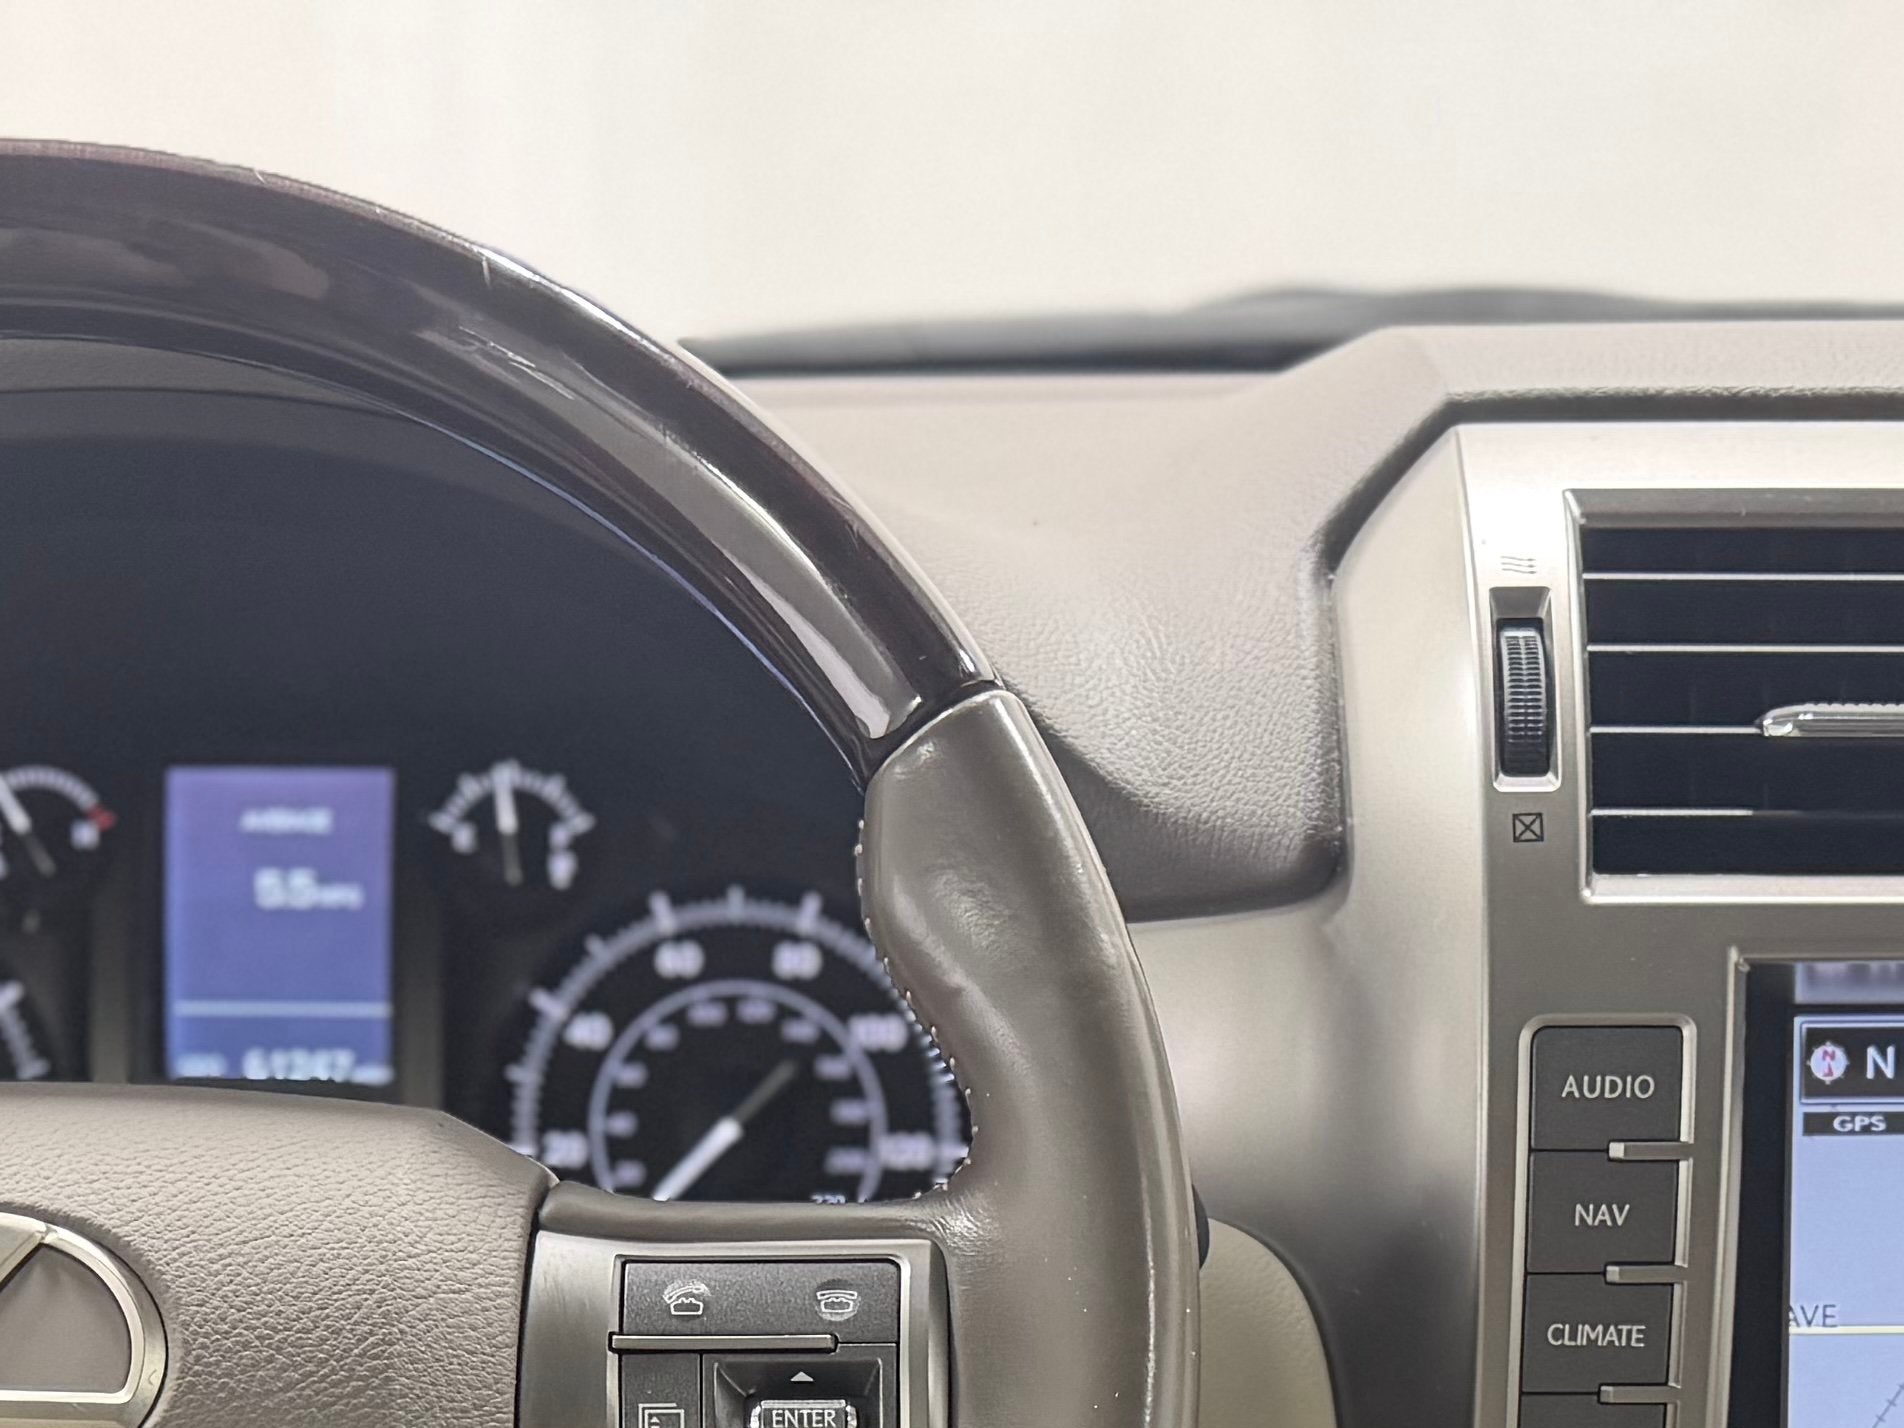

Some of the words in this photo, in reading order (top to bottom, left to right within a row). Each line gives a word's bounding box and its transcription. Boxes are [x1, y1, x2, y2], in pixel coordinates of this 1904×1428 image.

[1866, 1045, 1895, 1079] N
[1562, 1075, 1655, 1099] AUDIO
[1833, 1115, 1886, 1133] GPS
[1575, 1203, 1630, 1227] NAV
[1547, 1323, 1646, 1348] CLIMATE
[772, 1408, 836, 1428] ENTER
